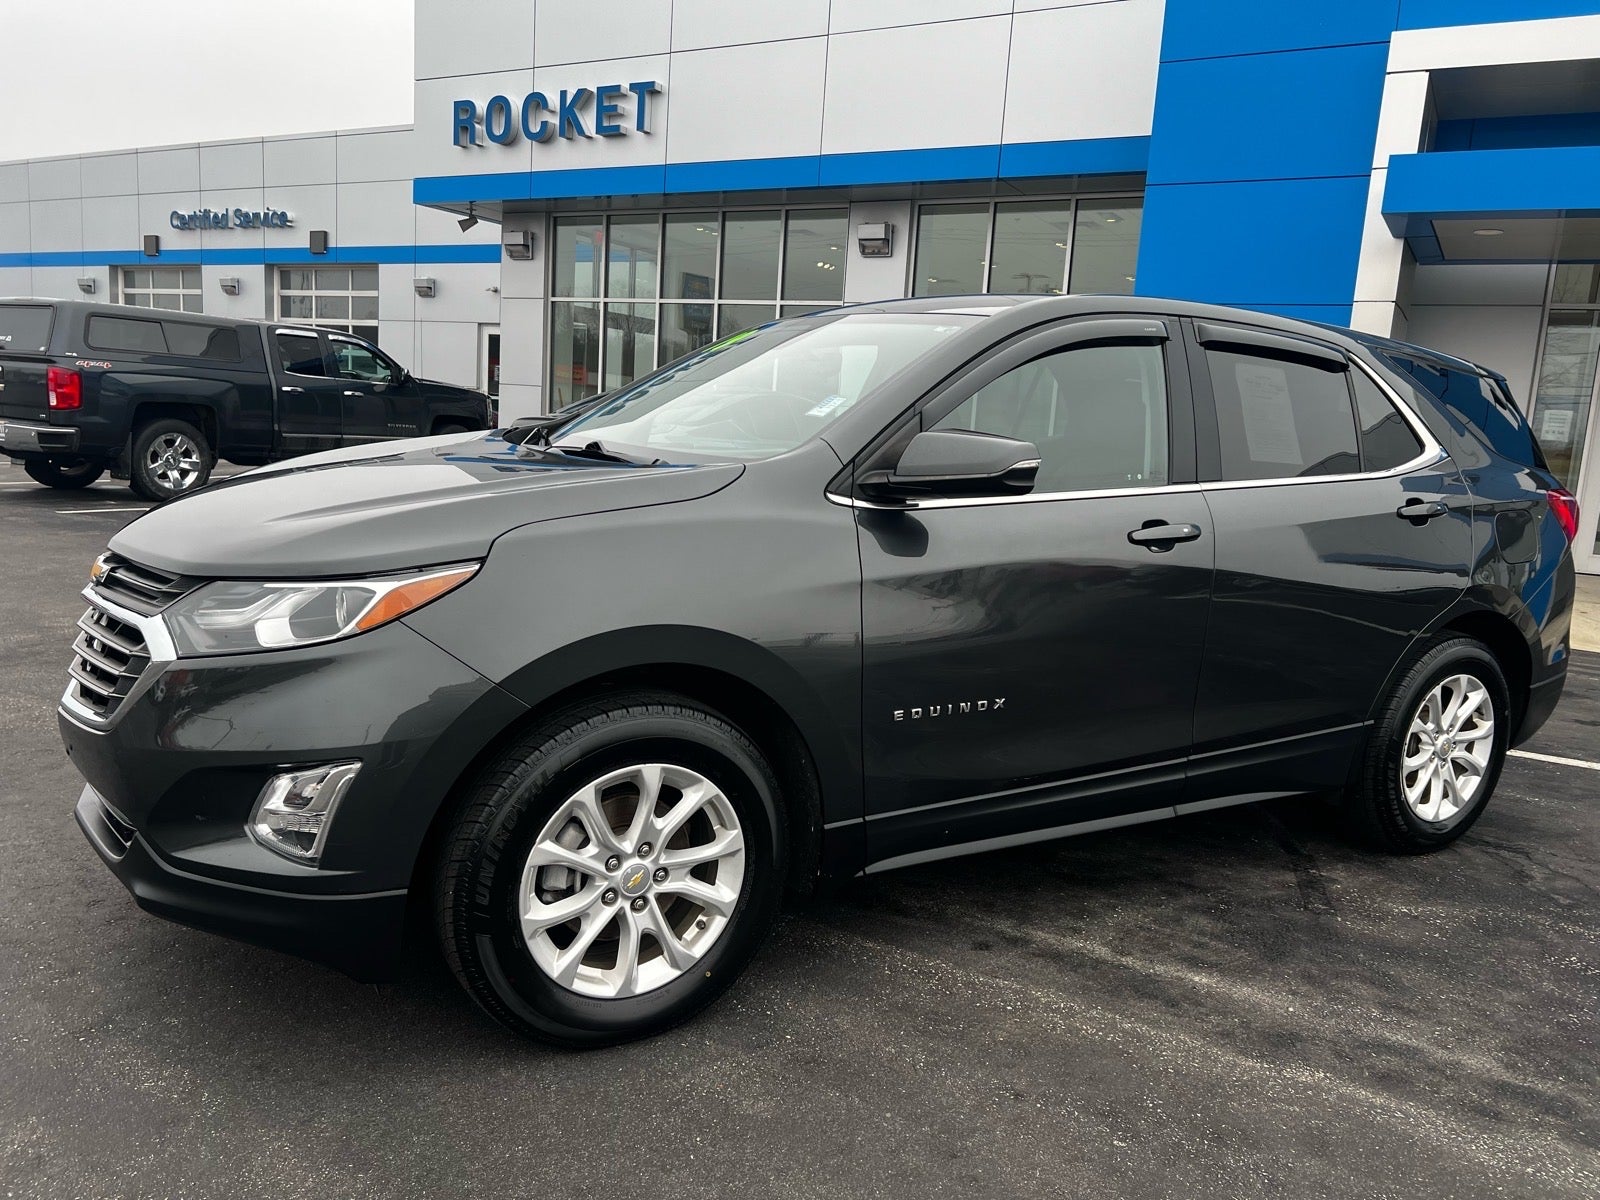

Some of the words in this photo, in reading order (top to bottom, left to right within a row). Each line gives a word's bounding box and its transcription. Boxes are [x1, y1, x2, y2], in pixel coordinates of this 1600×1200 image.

[453, 80, 661, 148] ROCKET
[170, 207, 229, 230] Certified
[233, 206, 292, 229] Service
[893, 697, 1006, 722] EQUINOX
